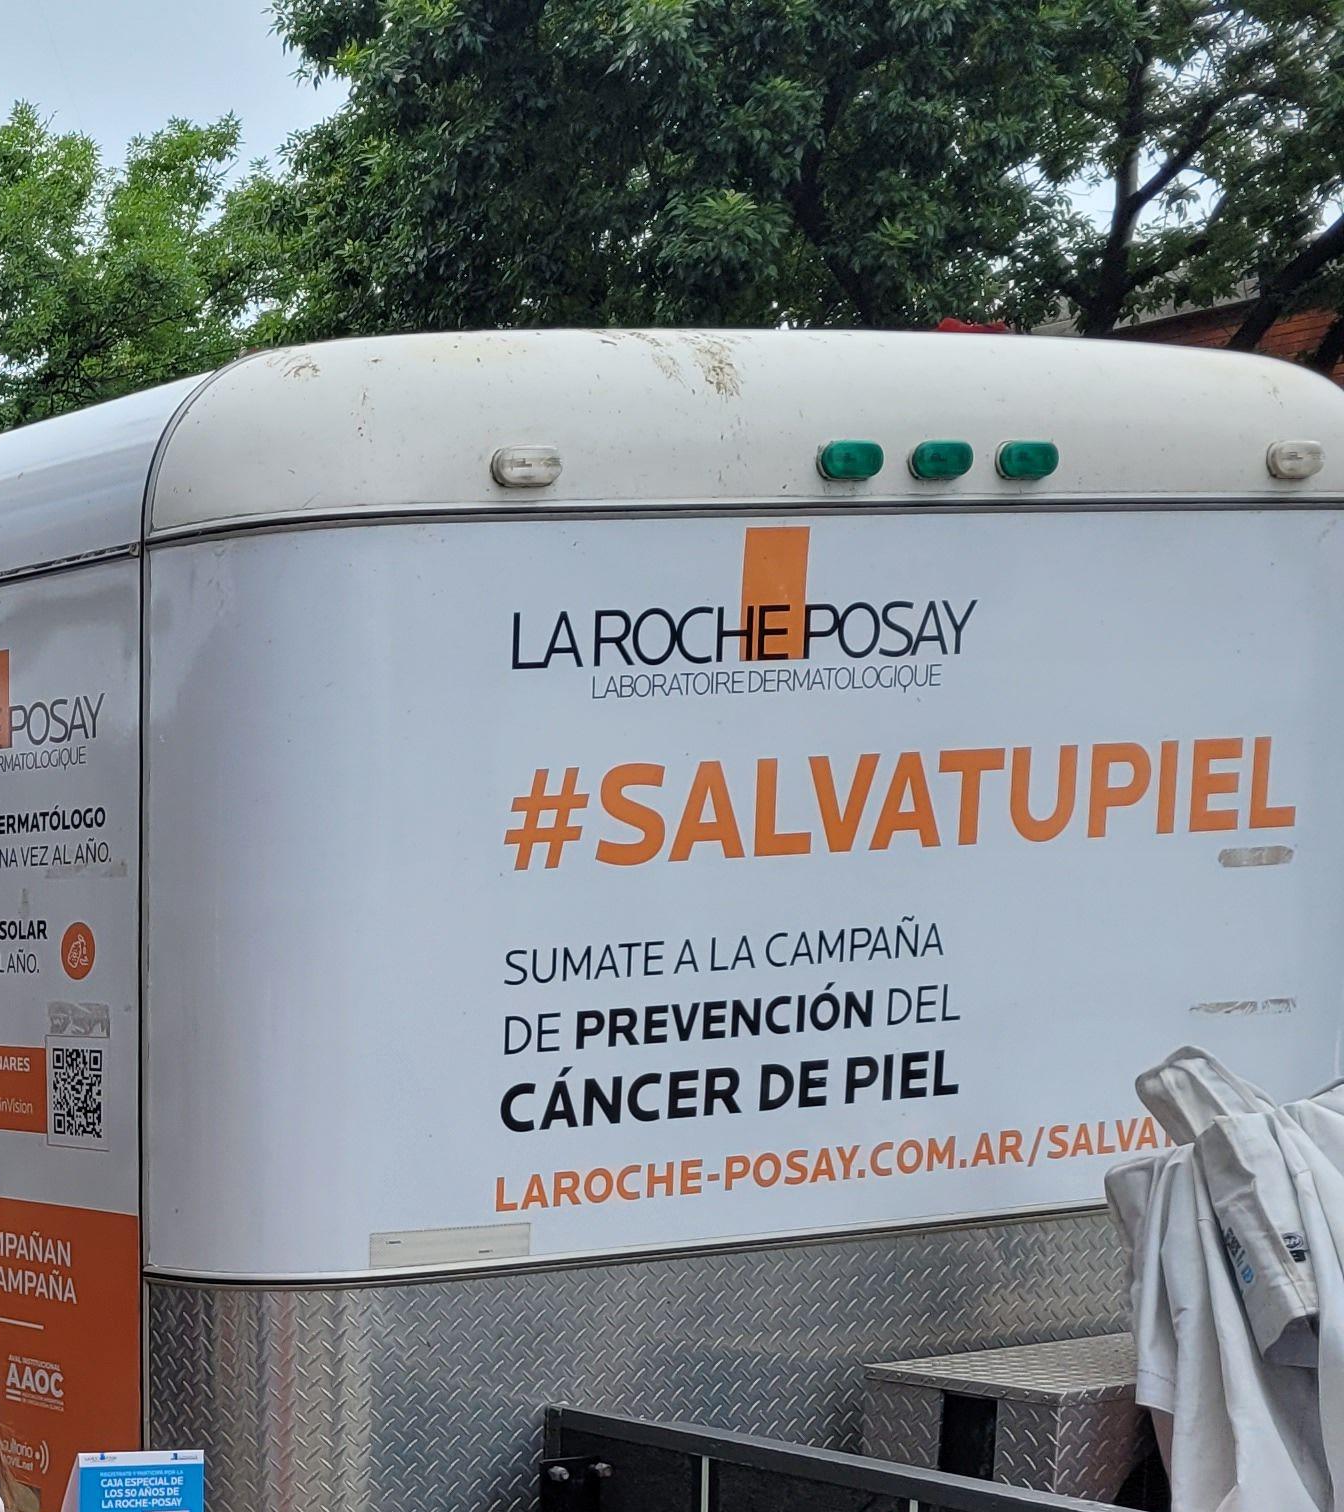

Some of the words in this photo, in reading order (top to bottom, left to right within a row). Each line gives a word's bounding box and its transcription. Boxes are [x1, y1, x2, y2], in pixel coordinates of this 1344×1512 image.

[511, 610, 584, 671] LA
[593, 605, 792, 669] ROCHE
[803, 599, 977, 660] POSAY
[591, 671, 745, 700] LABORATOIRE
[747, 663, 943, 694] DERMATOLOGIQUE
[9, 692, 105, 748] POSAY
[503, 735, 1297, 872] #SALVATUPIEL
[21, 845, 49, 867] VEZ
[52, 844, 72, 865] AL
[74, 837, 112, 864] AÑO.
[6, 949, 41, 974] AÑO.
[502, 939, 664, 987] SUMATE
[673, 937, 702, 976] A
[709, 935, 756, 973] LA
[763, 914, 945, 967] CAMPAÑA
[502, 1012, 561, 1056] DE
[574, 981, 875, 1052] PREVENCIÓN
[886, 983, 961, 1028] DEL
[499, 1066, 743, 1133] CÁNCER
[758, 1057, 828, 1114] DE
[844, 1048, 961, 1105] PIEL
[495, 1115, 1172, 1214] LAROCHE-POSAY.COM.AR/SALVA
[5, 1362, 65, 1399] AAOC
[100, 1478, 124, 1488] CAJA
[124, 1476, 171, 1487] ESPECIAL
[170, 1476, 184, 1485] DE
[101, 1499, 114, 1509] LA
[114, 1497, 183, 1509] ROCHE-POSAY
[104, 1488, 124, 1498] LOS
[123, 1488, 137, 1498] 50
[137, 1486, 166, 1497] AÑOS
[166, 1487, 180, 1496] DE
